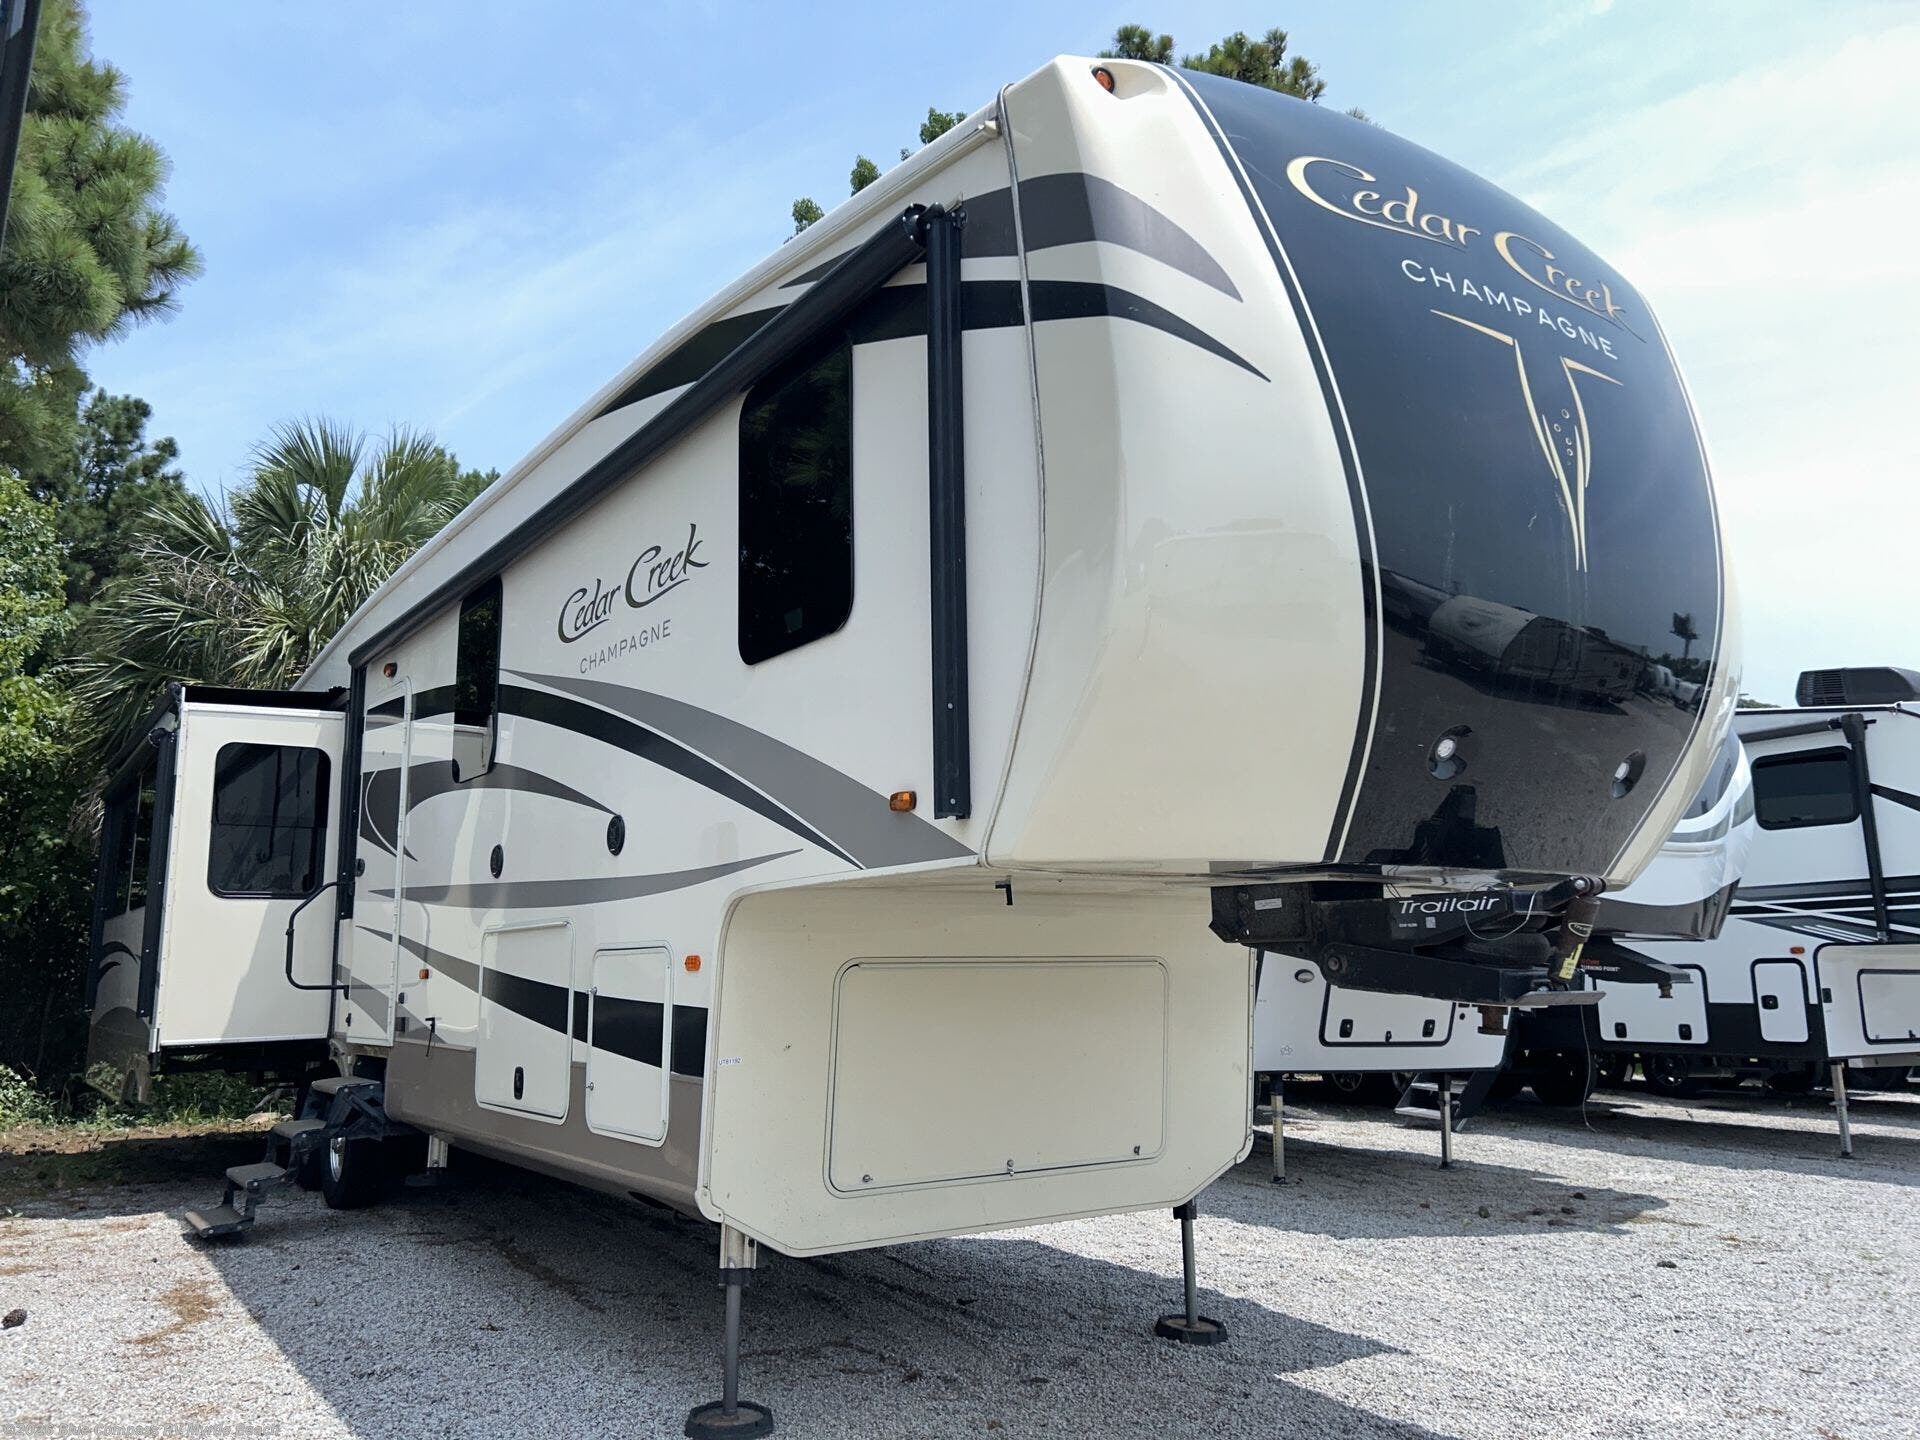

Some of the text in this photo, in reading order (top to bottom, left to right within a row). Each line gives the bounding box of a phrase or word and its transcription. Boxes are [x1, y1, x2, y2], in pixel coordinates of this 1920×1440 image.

[1286, 155, 1647, 343] Cedar Creek
[1401, 258, 1619, 361] CHAMPAGNE
[558, 523, 710, 643] Cedar Creek
[579, 619, 672, 674] CHAMPAGNE
[1399, 896, 1499, 914] Trailair
